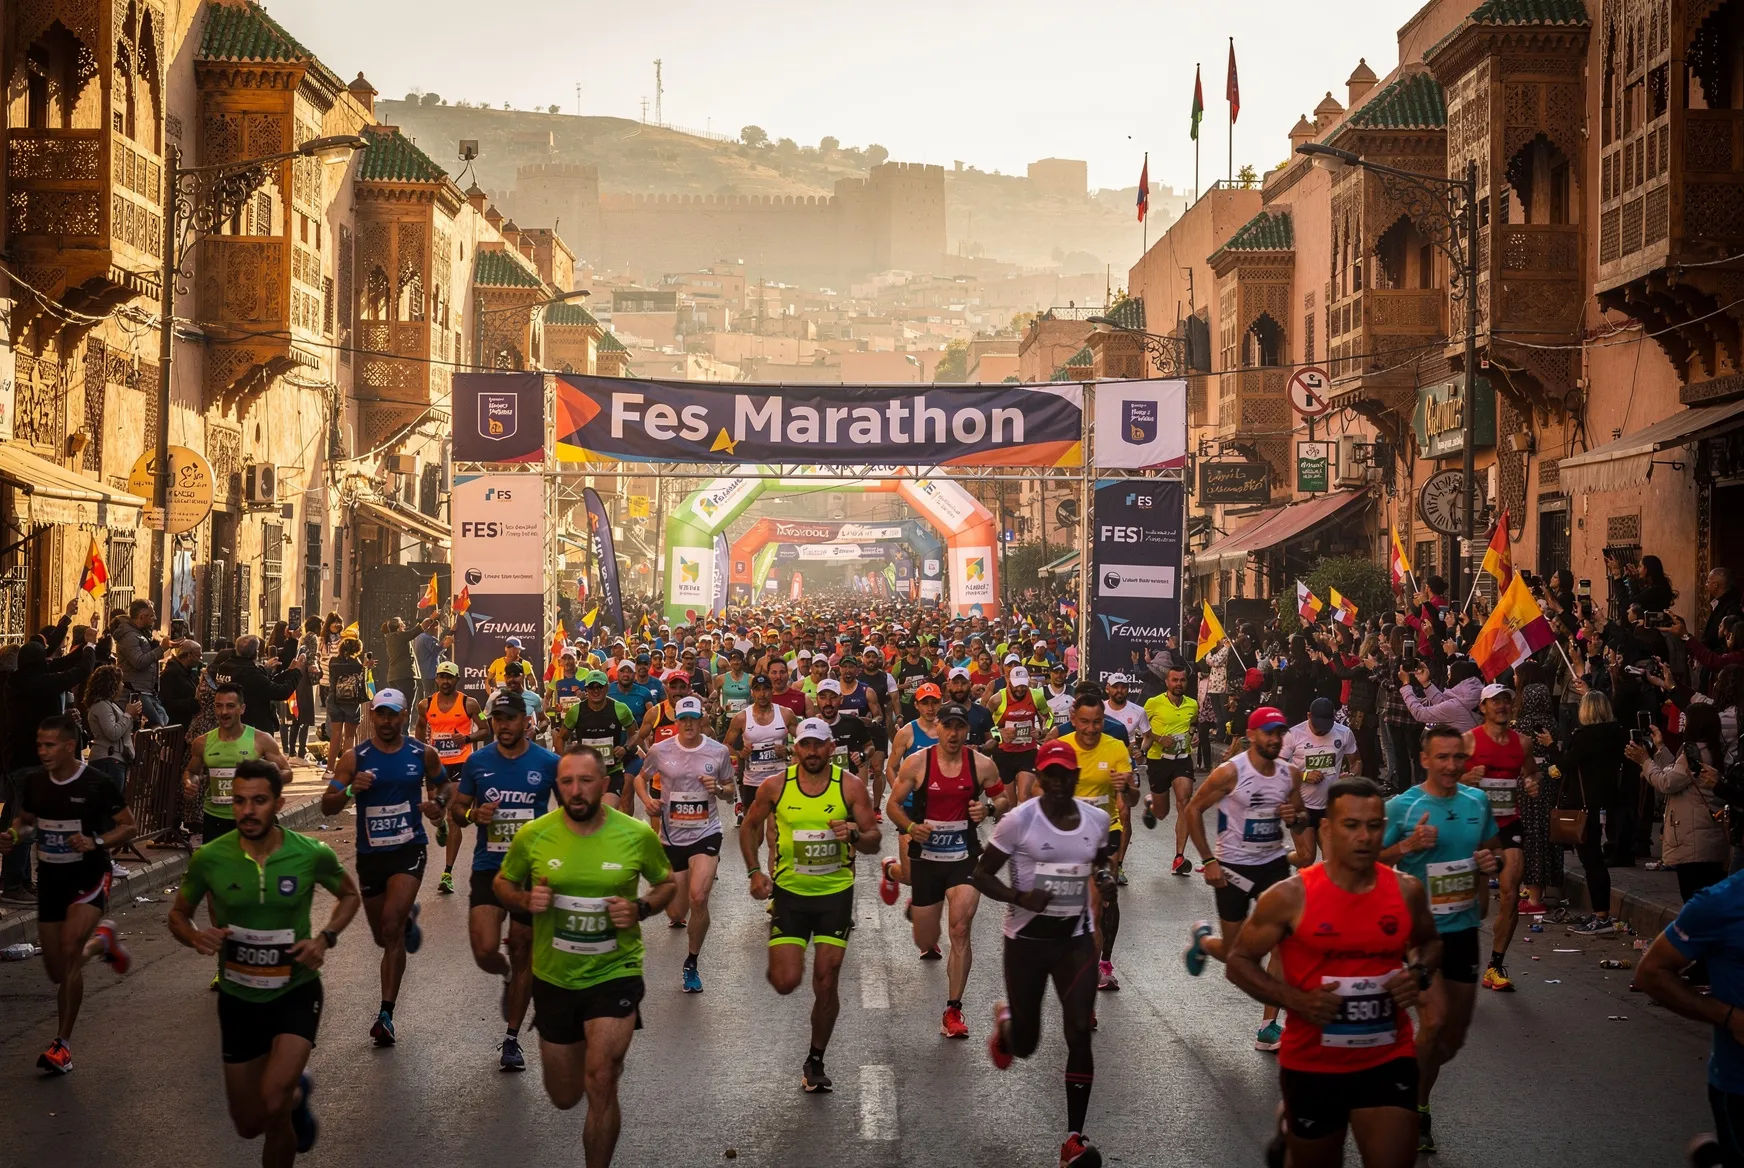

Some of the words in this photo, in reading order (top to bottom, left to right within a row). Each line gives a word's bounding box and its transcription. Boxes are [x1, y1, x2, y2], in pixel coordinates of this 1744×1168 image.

[611, 391, 709, 441] Fes
[734, 393, 1025, 444] Marathon
[461, 521, 498, 538] FES
[1101, 525, 1139, 543] FES
